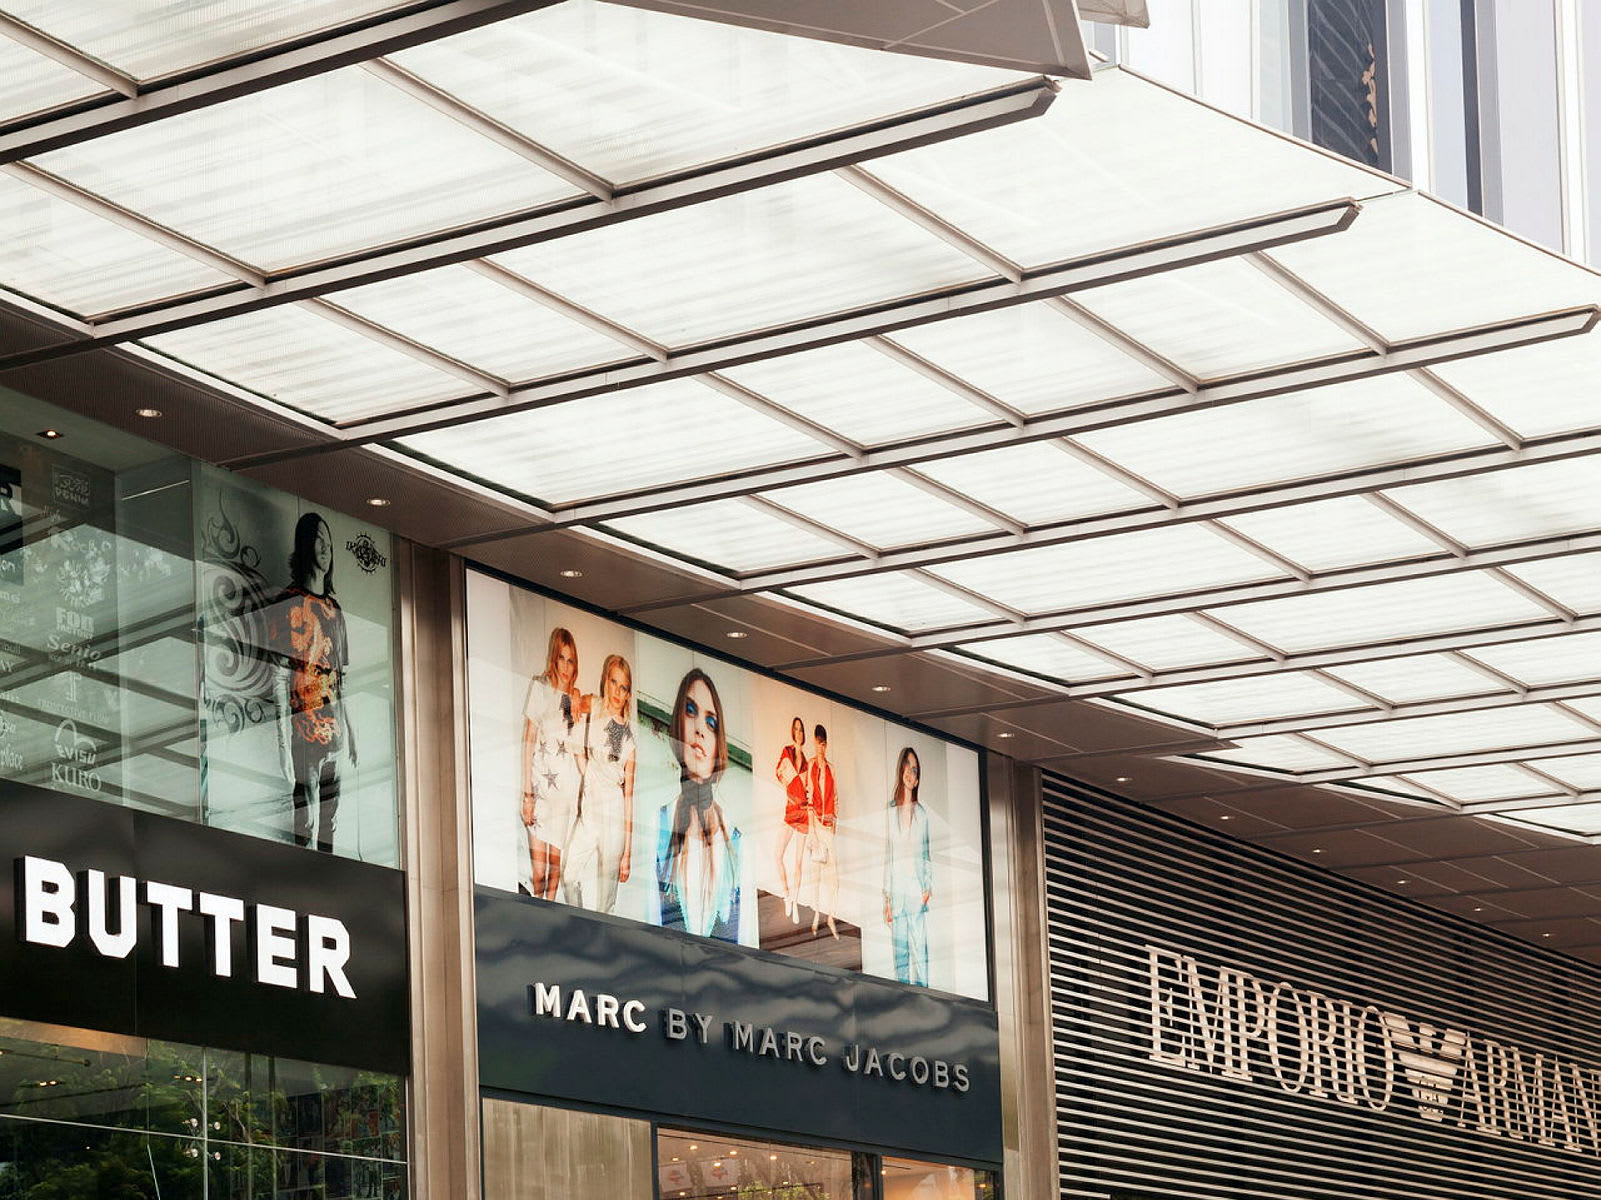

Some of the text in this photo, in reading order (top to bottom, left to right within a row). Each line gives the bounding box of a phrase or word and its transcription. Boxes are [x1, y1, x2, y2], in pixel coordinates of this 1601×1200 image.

[51, 762, 102, 792] KURO
[22, 855, 357, 999] BUTTER
[534, 982, 970, 1092] MARC BY MARC JACOBS
[1145, 944, 1601, 1157] EMPORIO ARMAN
